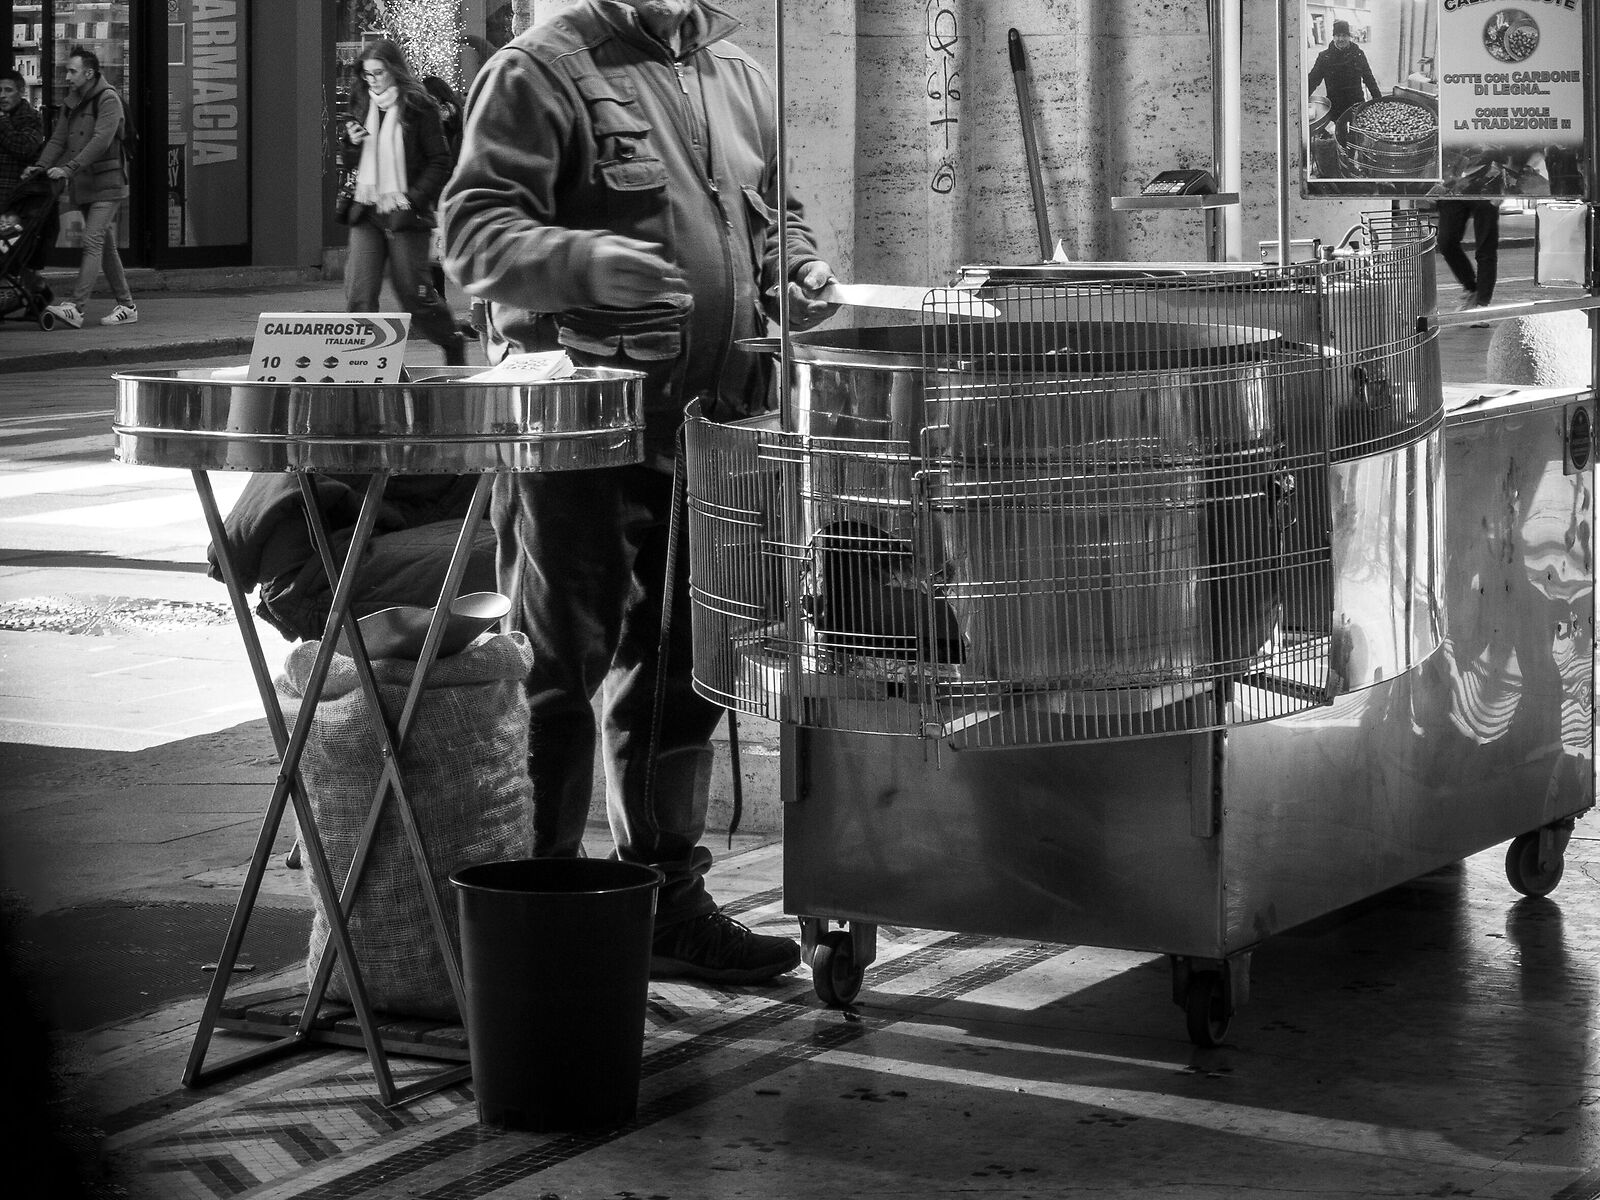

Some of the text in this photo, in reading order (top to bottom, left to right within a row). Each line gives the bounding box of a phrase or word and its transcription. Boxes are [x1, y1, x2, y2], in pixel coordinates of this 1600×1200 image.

[1443, 70, 1581, 84] COTTE CON CARBONE
[1474, 84, 1489, 95] DI
[1475, 107, 1550, 118] COME VUOLE
[1454, 119, 1469, 130] LA
[1471, 117, 1558, 130] TRADIZIONE
[264, 323, 374, 336] CALDARROSTE
[261, 356, 281, 369] 10
[376, 357, 388, 369] 3
